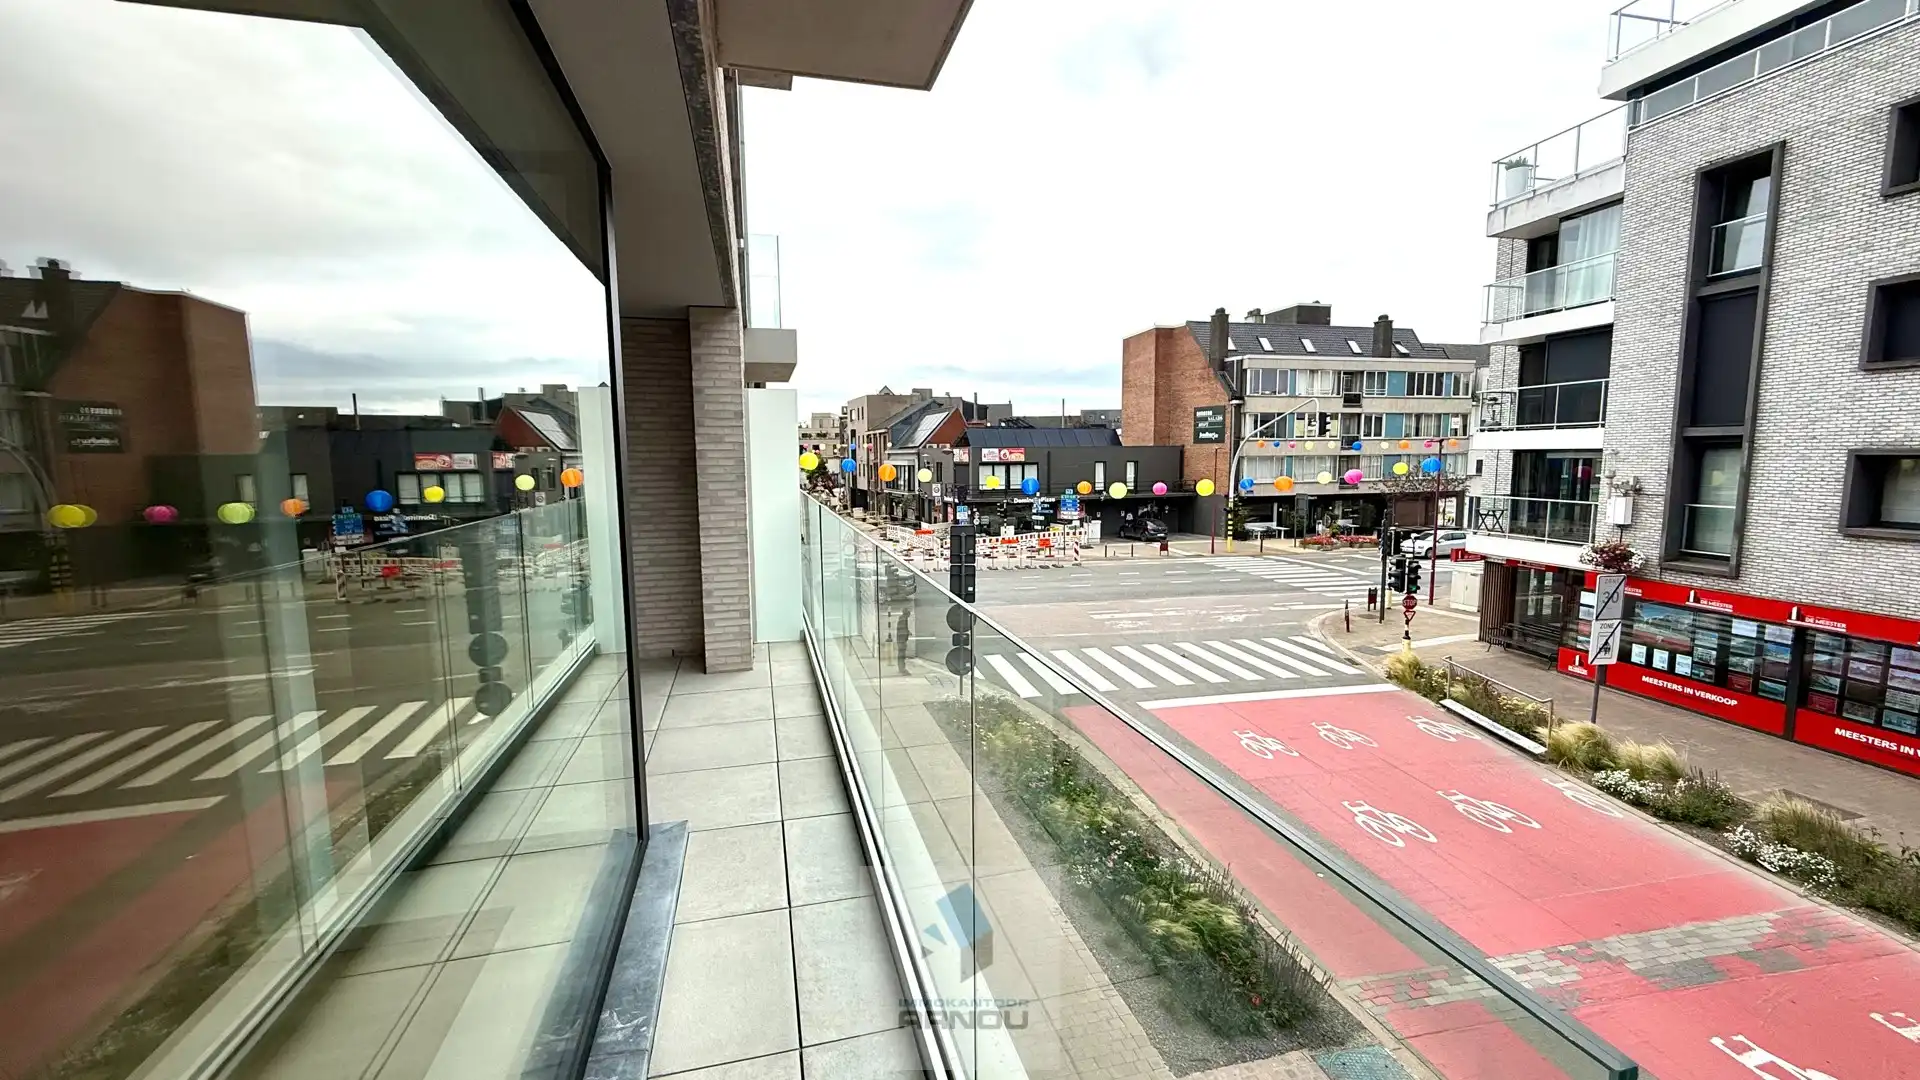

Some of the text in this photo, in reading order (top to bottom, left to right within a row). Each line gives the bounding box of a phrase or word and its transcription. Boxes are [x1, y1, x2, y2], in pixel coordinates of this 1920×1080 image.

[1602, 591, 1620, 604] 30
[1708, 600, 1734, 609] MEESTER
[1815, 618, 1847, 629] MEESTER
[1641, 675, 1738, 706] MEESTERS IN VERKOOP
[1834, 727, 1898, 751] MEESTERS
[1899, 744, 1915, 756] IN
